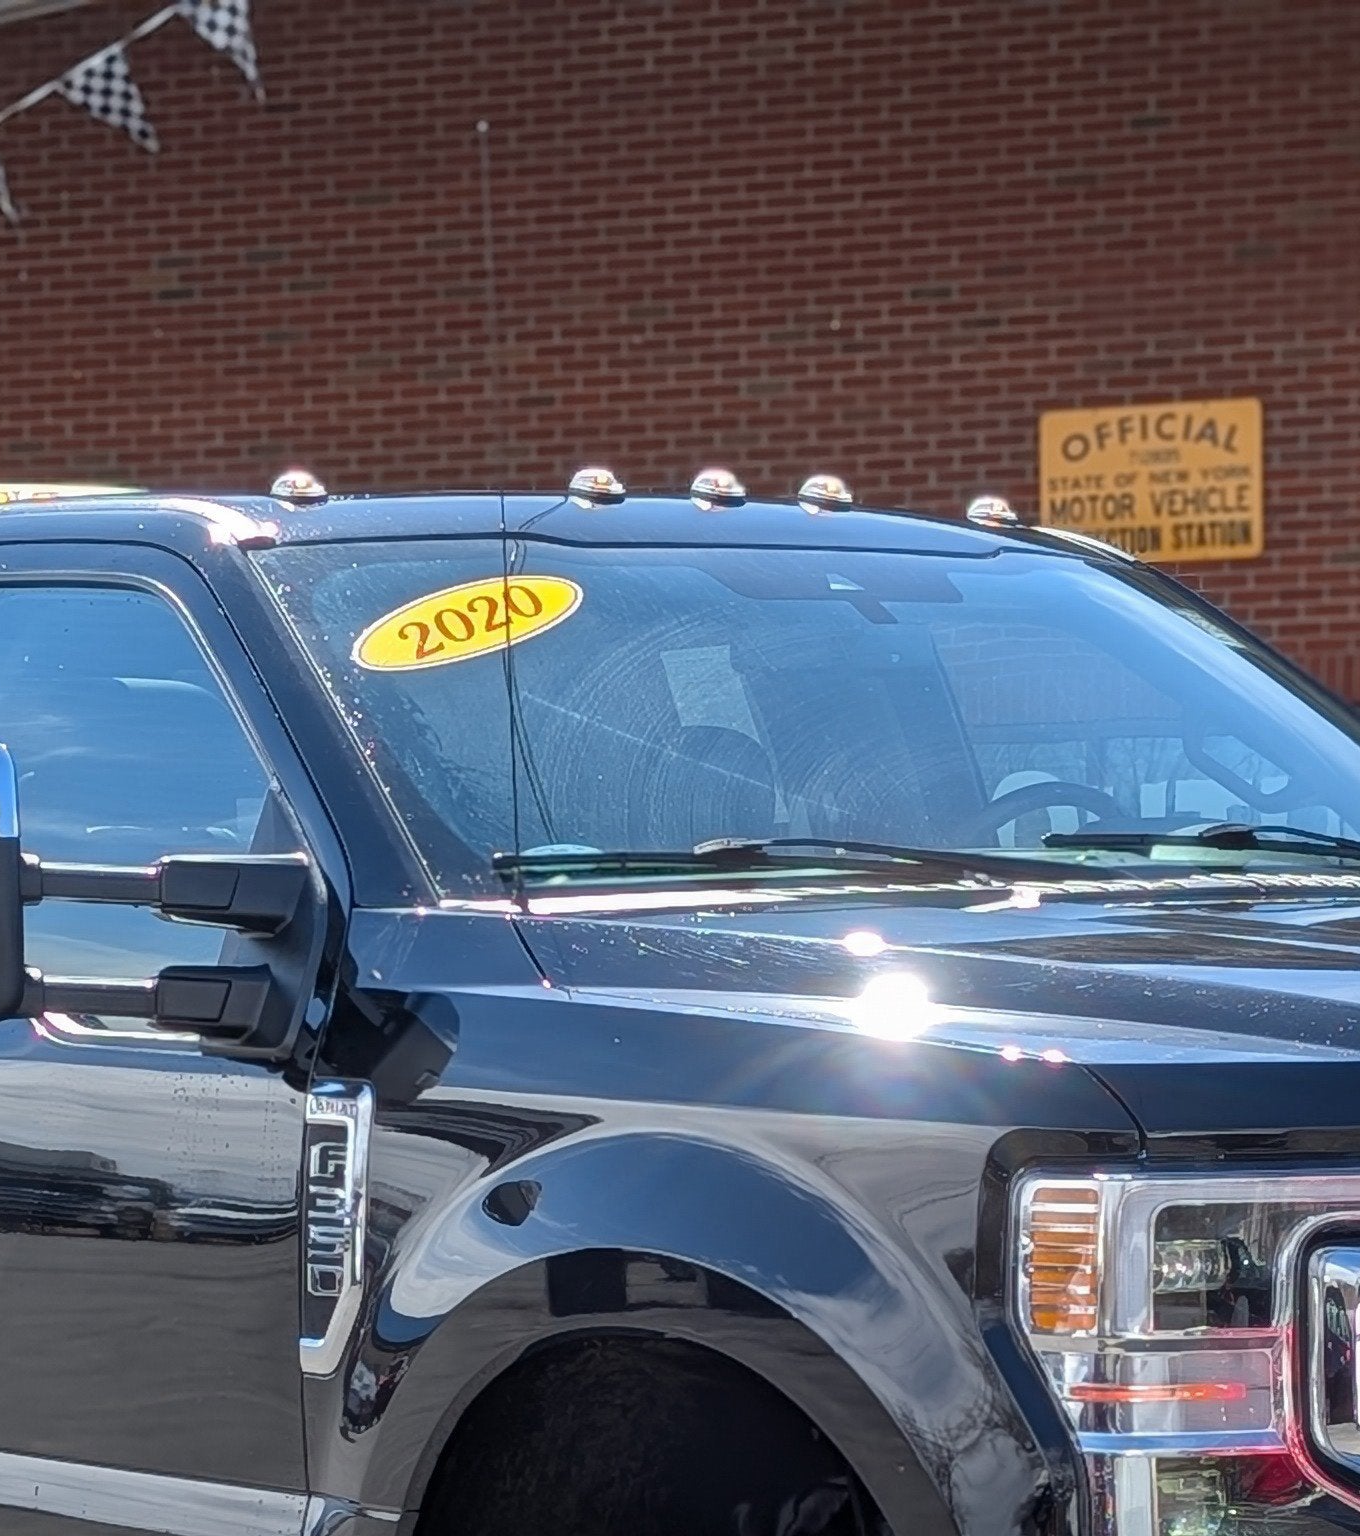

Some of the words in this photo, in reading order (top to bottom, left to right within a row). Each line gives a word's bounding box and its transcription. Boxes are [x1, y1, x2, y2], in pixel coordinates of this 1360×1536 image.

[1062, 412, 1238, 462] OFFICIAL
[1047, 473, 1104, 491] STATE
[1113, 471, 1137, 489] OF
[1049, 493, 1136, 524] MOTOR
[1148, 485, 1249, 517] VEHICLE
[1171, 520, 1252, 550] STATION
[398, 585, 543, 660] 2020
